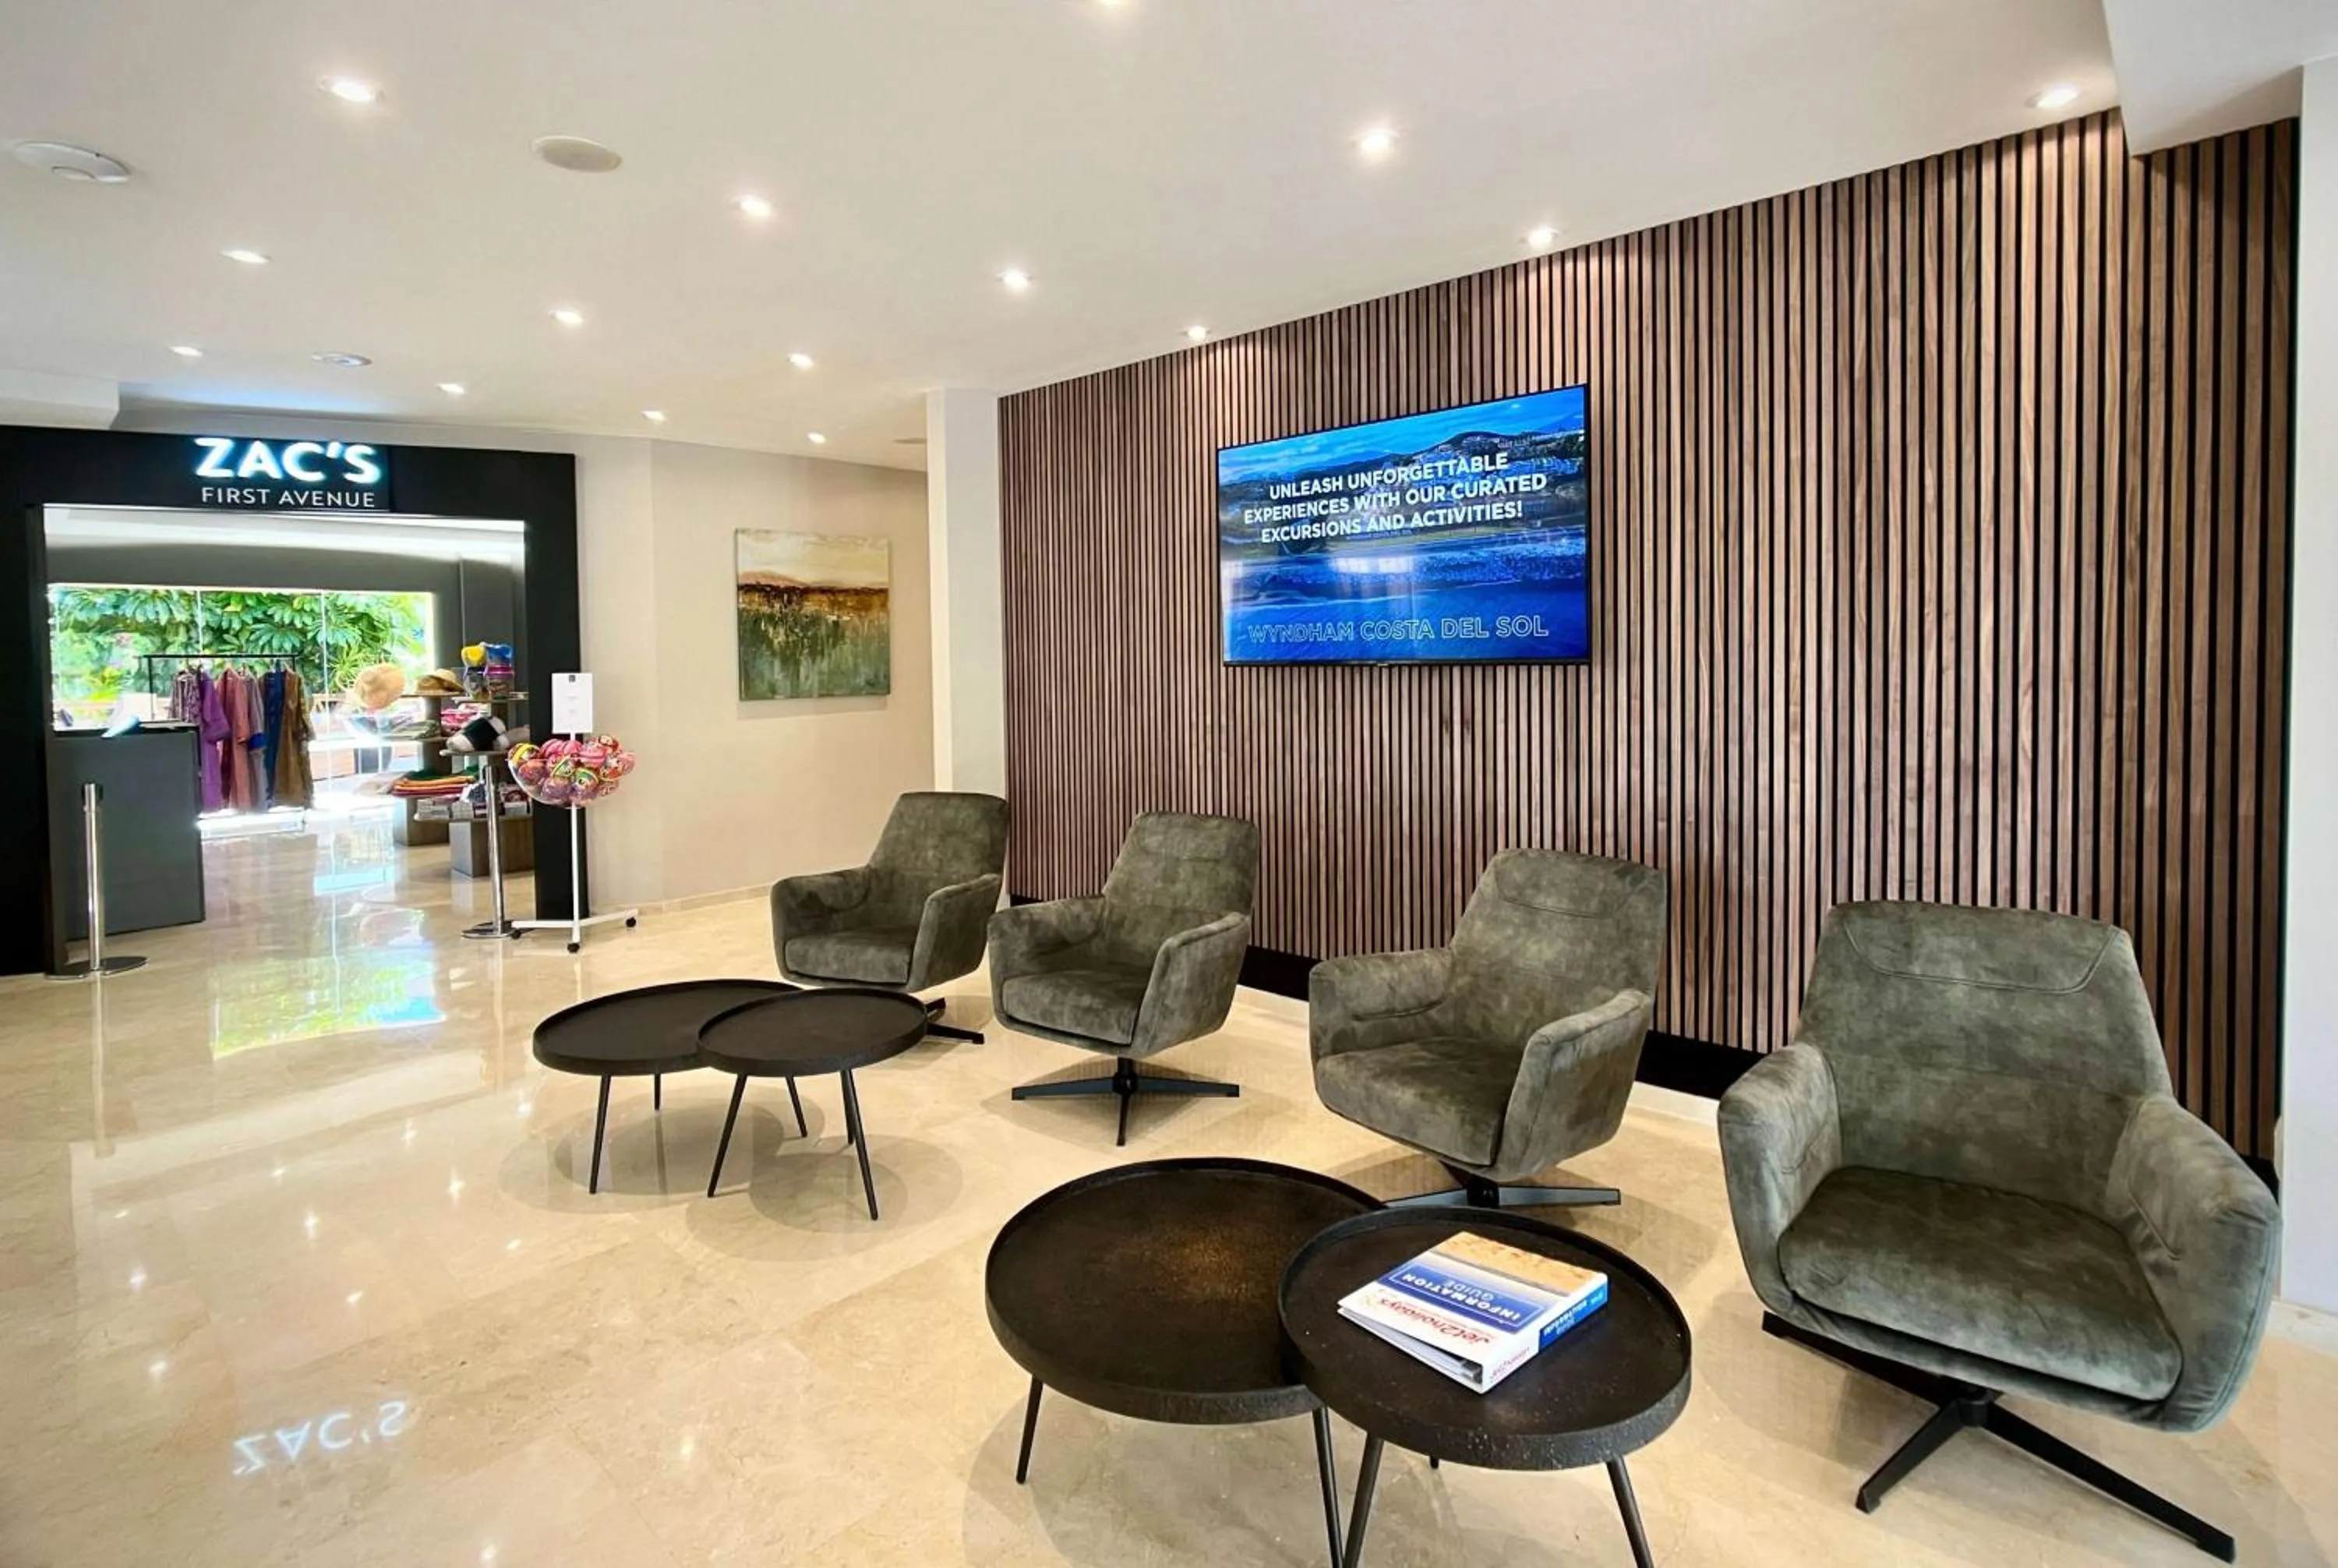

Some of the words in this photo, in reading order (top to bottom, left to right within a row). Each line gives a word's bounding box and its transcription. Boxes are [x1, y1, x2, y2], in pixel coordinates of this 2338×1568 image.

[195, 437, 382, 484] ZAC'S
[1269, 475, 1343, 500] UNLEASH
[1347, 452, 1508, 490] UNFORGETTABLE
[201, 487, 270, 505] FIRST
[278, 490, 375, 507] AVENUE
[1244, 498, 1349, 524] EXPERIENCES
[1354, 492, 1400, 510] WITH
[1405, 489, 1446, 505] OUR
[1450, 473, 1547, 500] CURATED
[1261, 520, 1361, 543] EXCURSIONS
[1366, 513, 1405, 531] AND
[1410, 500, 1523, 528] ACTIVITIES!
[1248, 622, 1354, 643] WYNDHAM
[1359, 619, 1435, 641] COSTA
[1441, 616, 1489, 639] DEL
[1496, 614, 1549, 637] SOL
[1402, 1273, 1520, 1322] INFORMATION
[1443, 1278, 1495, 1301] GUIDE
